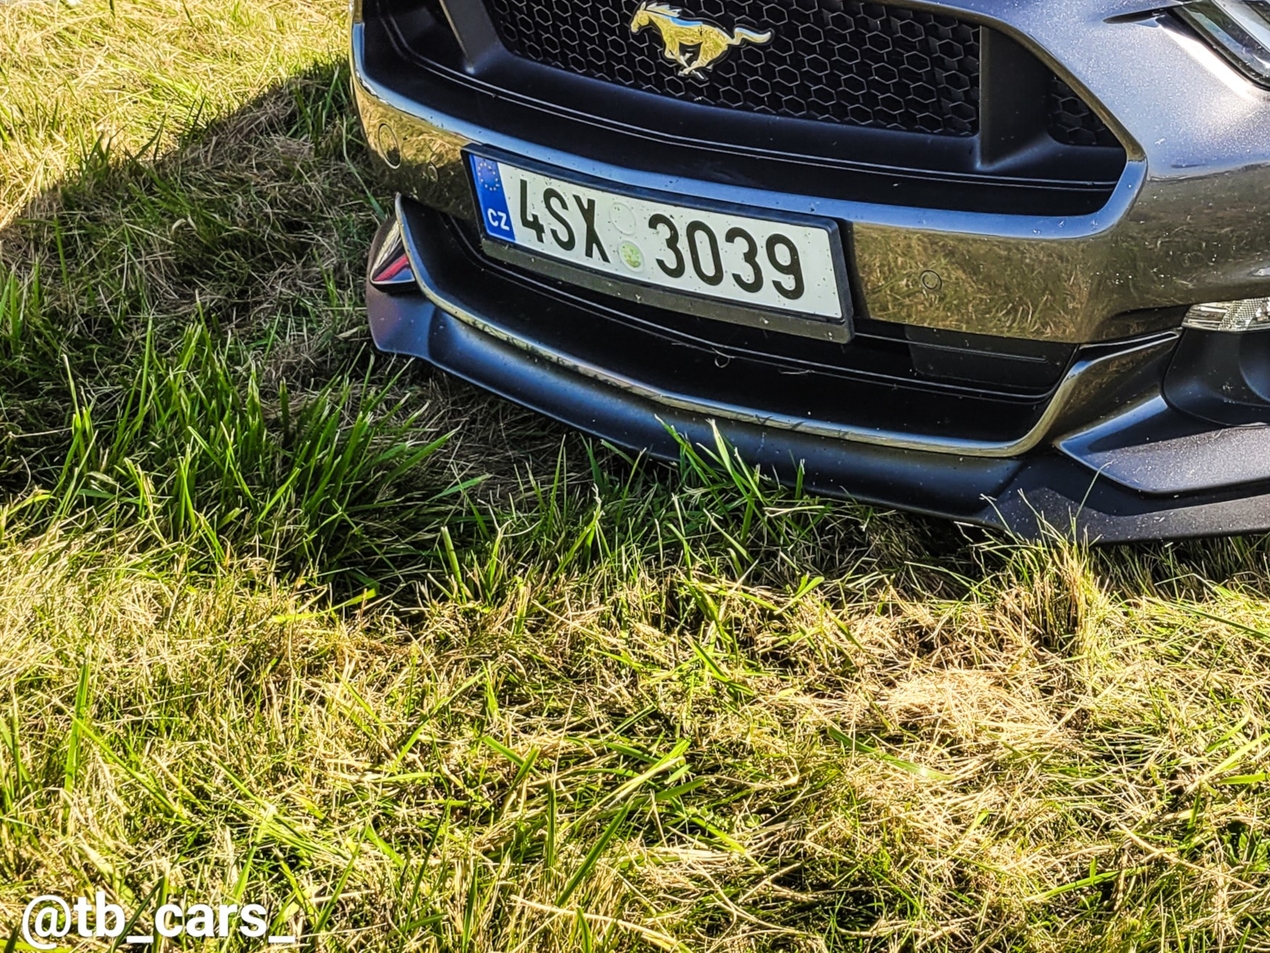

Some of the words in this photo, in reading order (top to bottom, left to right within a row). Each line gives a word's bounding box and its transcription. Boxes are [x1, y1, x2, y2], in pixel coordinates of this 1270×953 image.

[487, 208, 510, 231] CZ
[520, 179, 611, 263] 4SX
[649, 213, 804, 300] 3039
